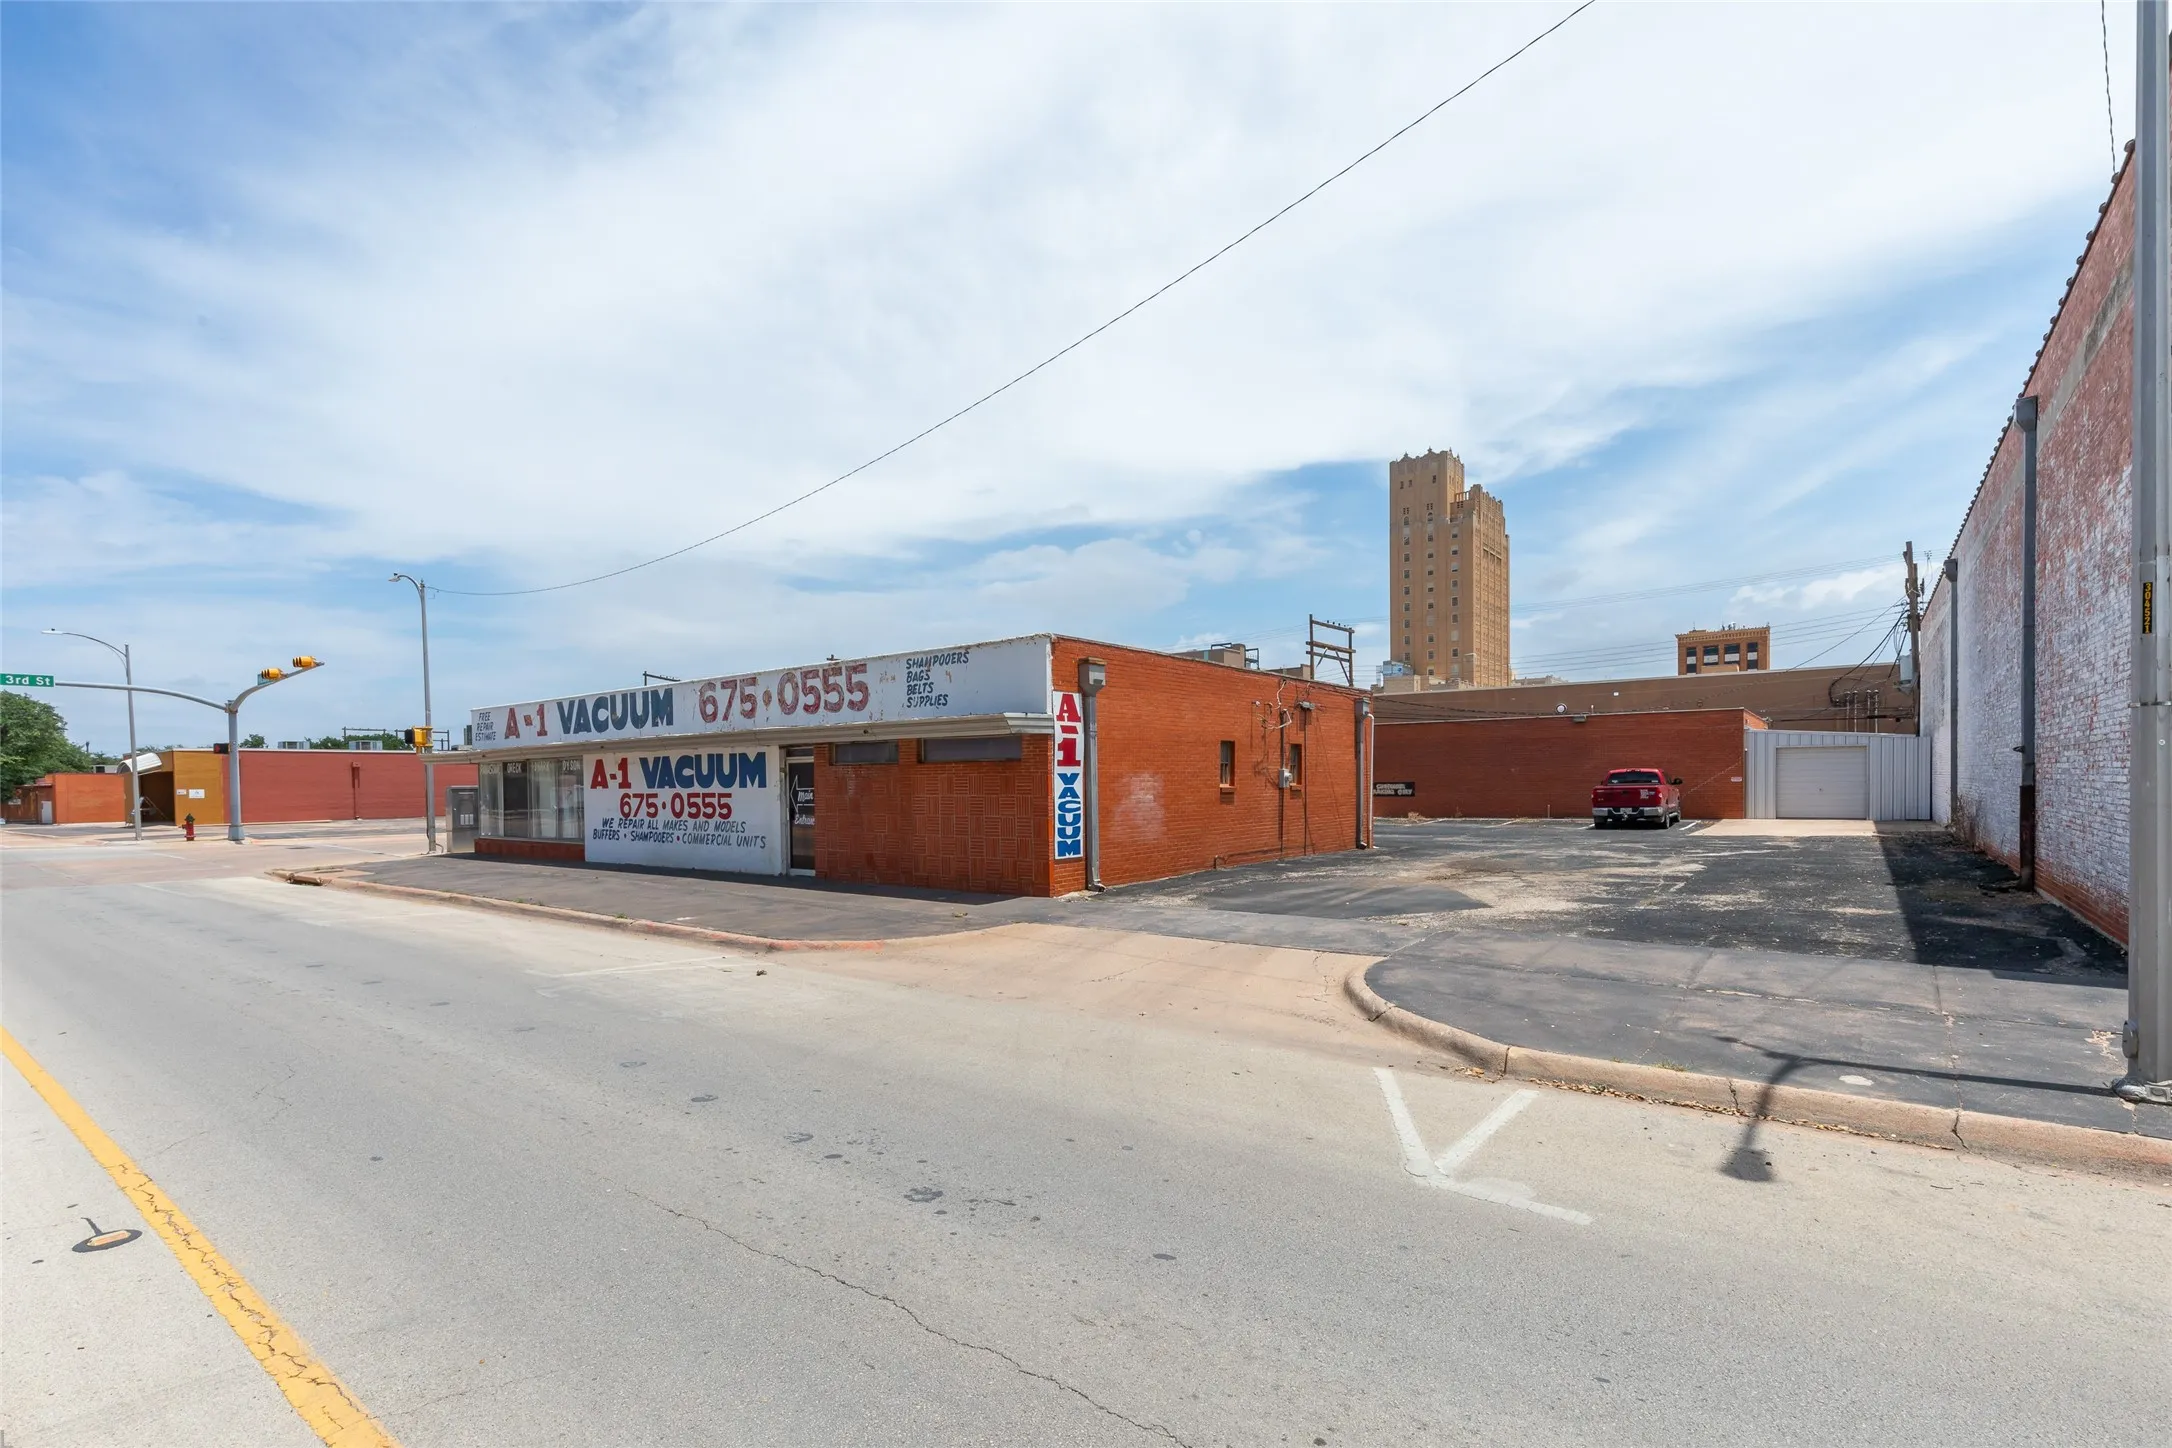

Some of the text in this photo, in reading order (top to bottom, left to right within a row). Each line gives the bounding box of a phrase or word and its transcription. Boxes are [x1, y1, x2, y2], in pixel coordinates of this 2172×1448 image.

[906, 650, 970, 670] SHAMPOOERS
[5, 675, 51, 686] 3rd St
[906, 669, 931, 683] BAGS
[906, 682, 934, 696] BELTS
[906, 693, 949, 708] SUPPLIES
[478, 711, 492, 722] FREE
[504, 688, 674, 740] A-1 VACUUM
[476, 721, 494, 732] REPAIR
[590, 752, 767, 789] A-1 VACUUM
[1056, 694, 1081, 857] A-1 VACUUM
[602, 817, 747, 834] WE REPAIR ALL MAKES AND MODELS
[592, 828, 767, 850] BUFFERS SHAMPOOERS COMMERCIAL UNITS
